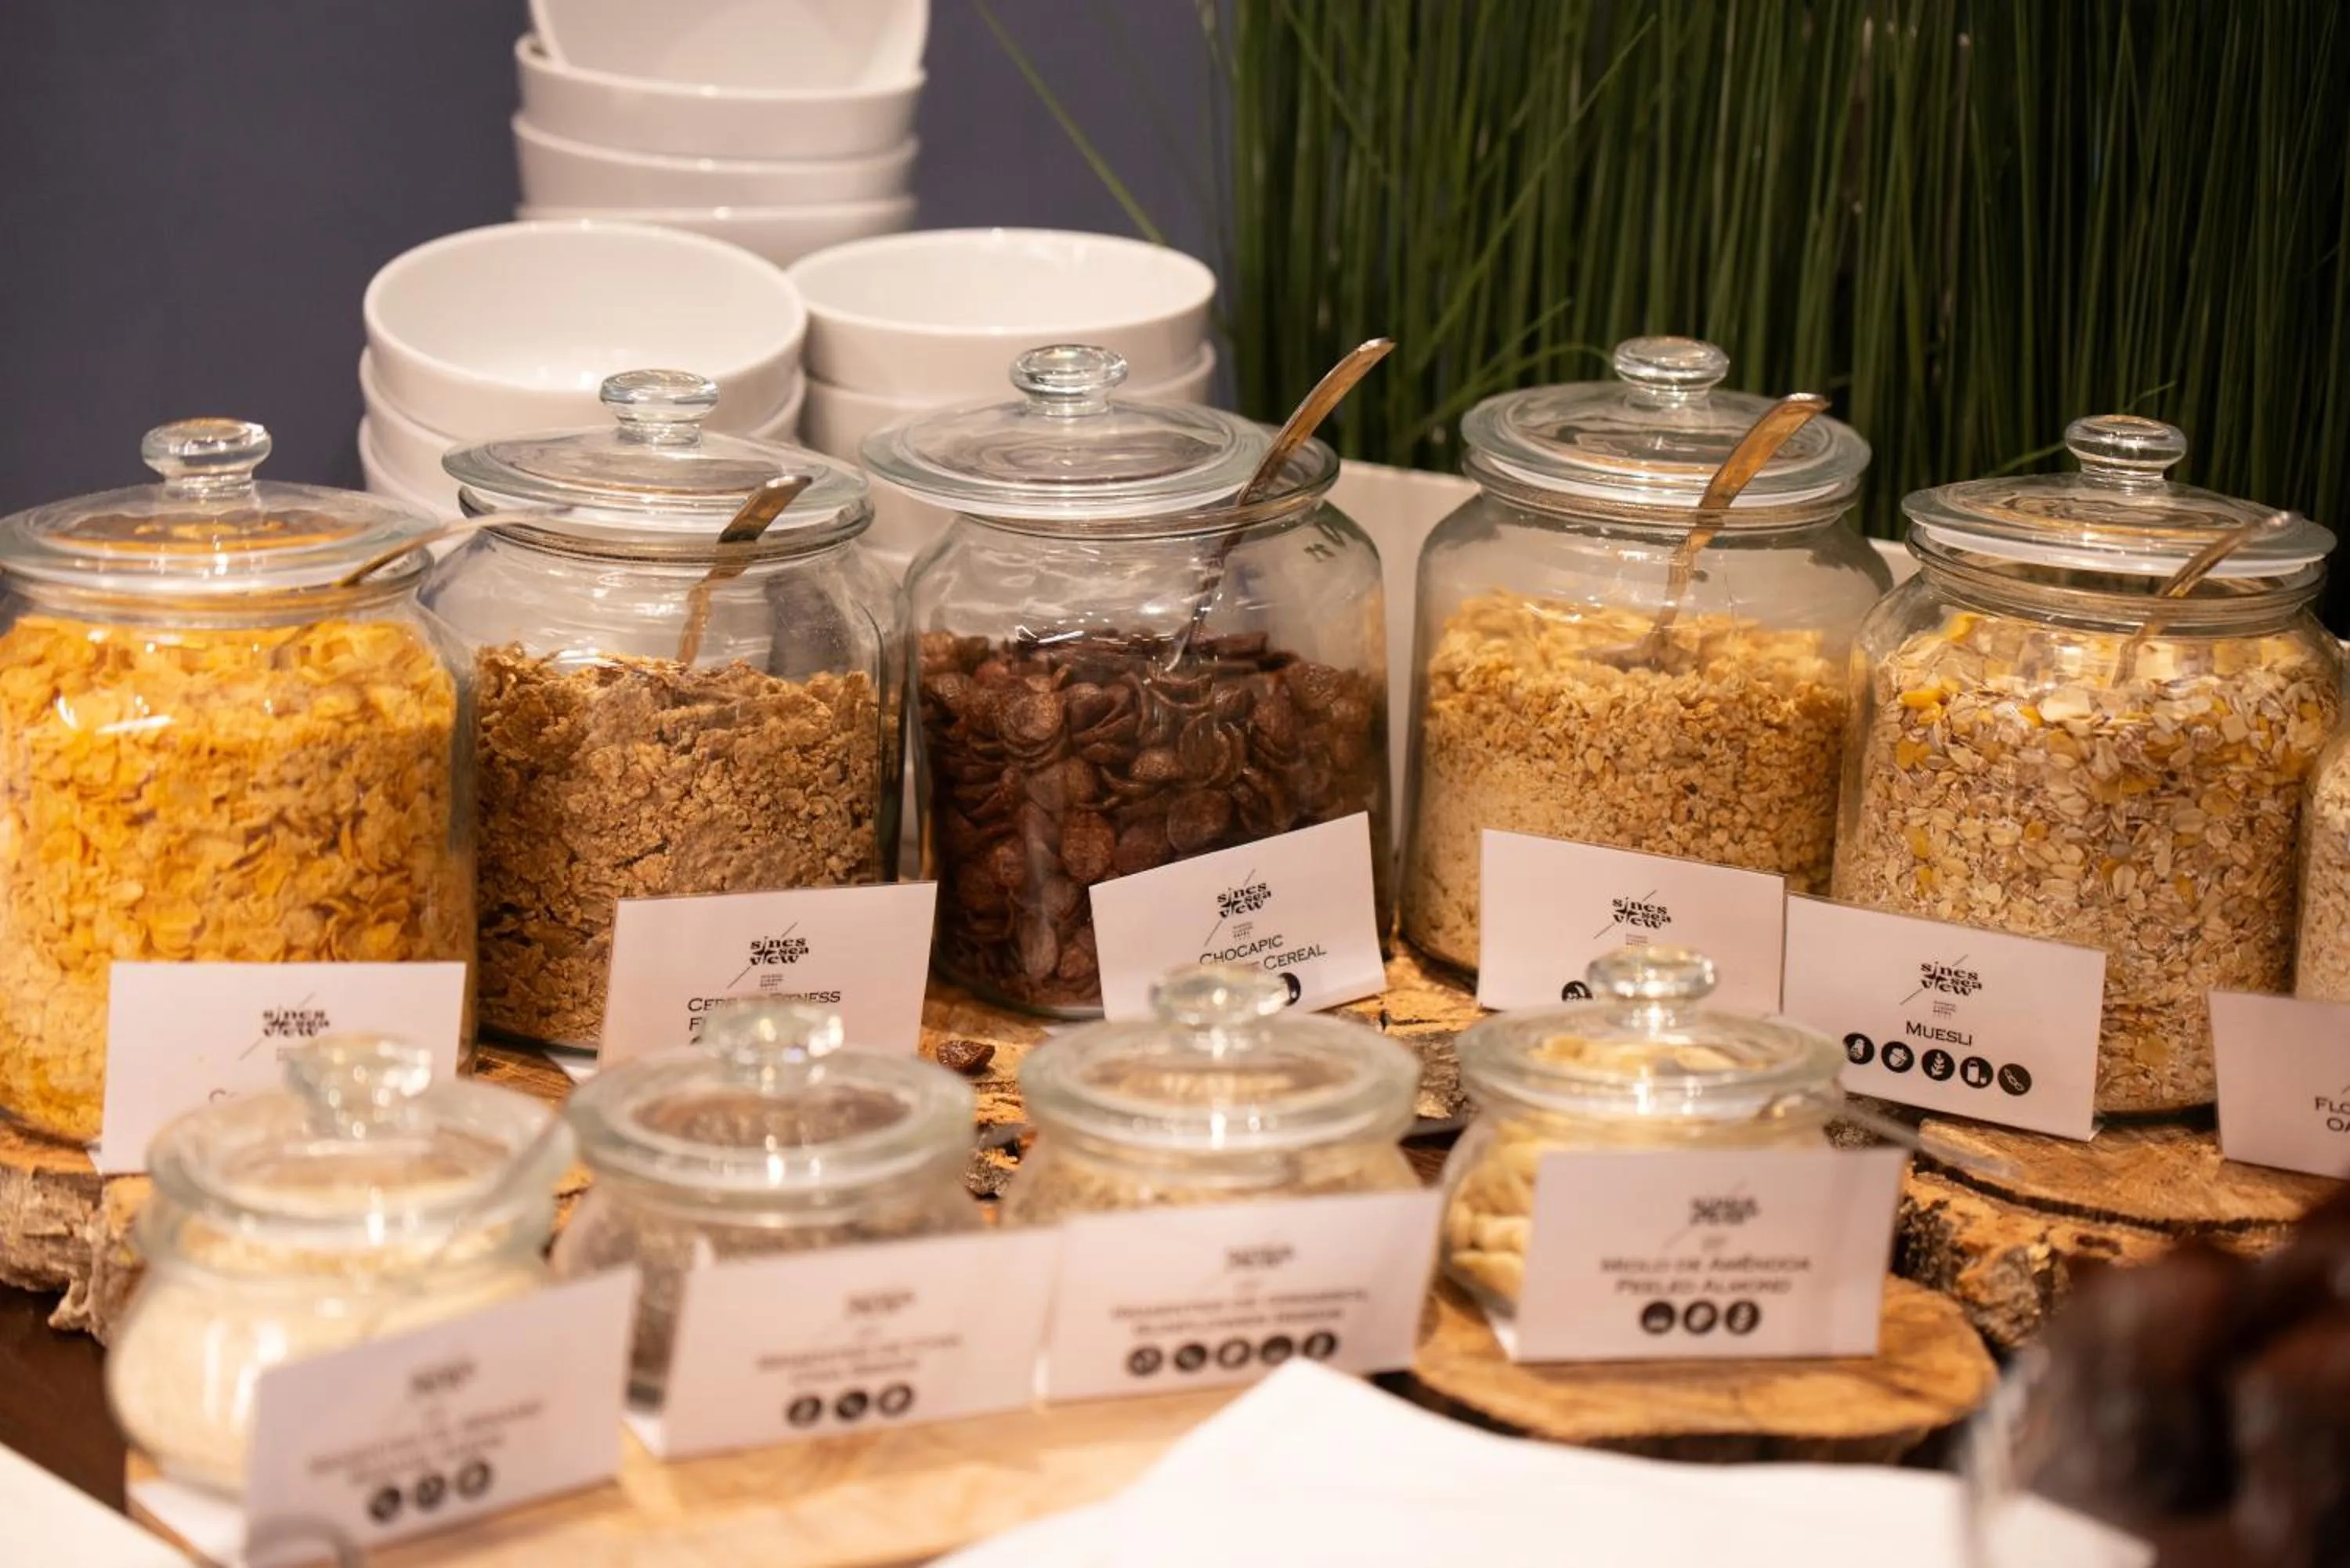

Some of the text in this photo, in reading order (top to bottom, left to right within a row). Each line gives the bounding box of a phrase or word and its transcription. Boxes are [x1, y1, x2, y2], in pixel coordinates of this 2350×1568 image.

[1199, 934, 1284, 966] CHOCAPIC
[1264, 944, 1327, 970] CEREAL
[1905, 1021, 1973, 1046] MUESLI
